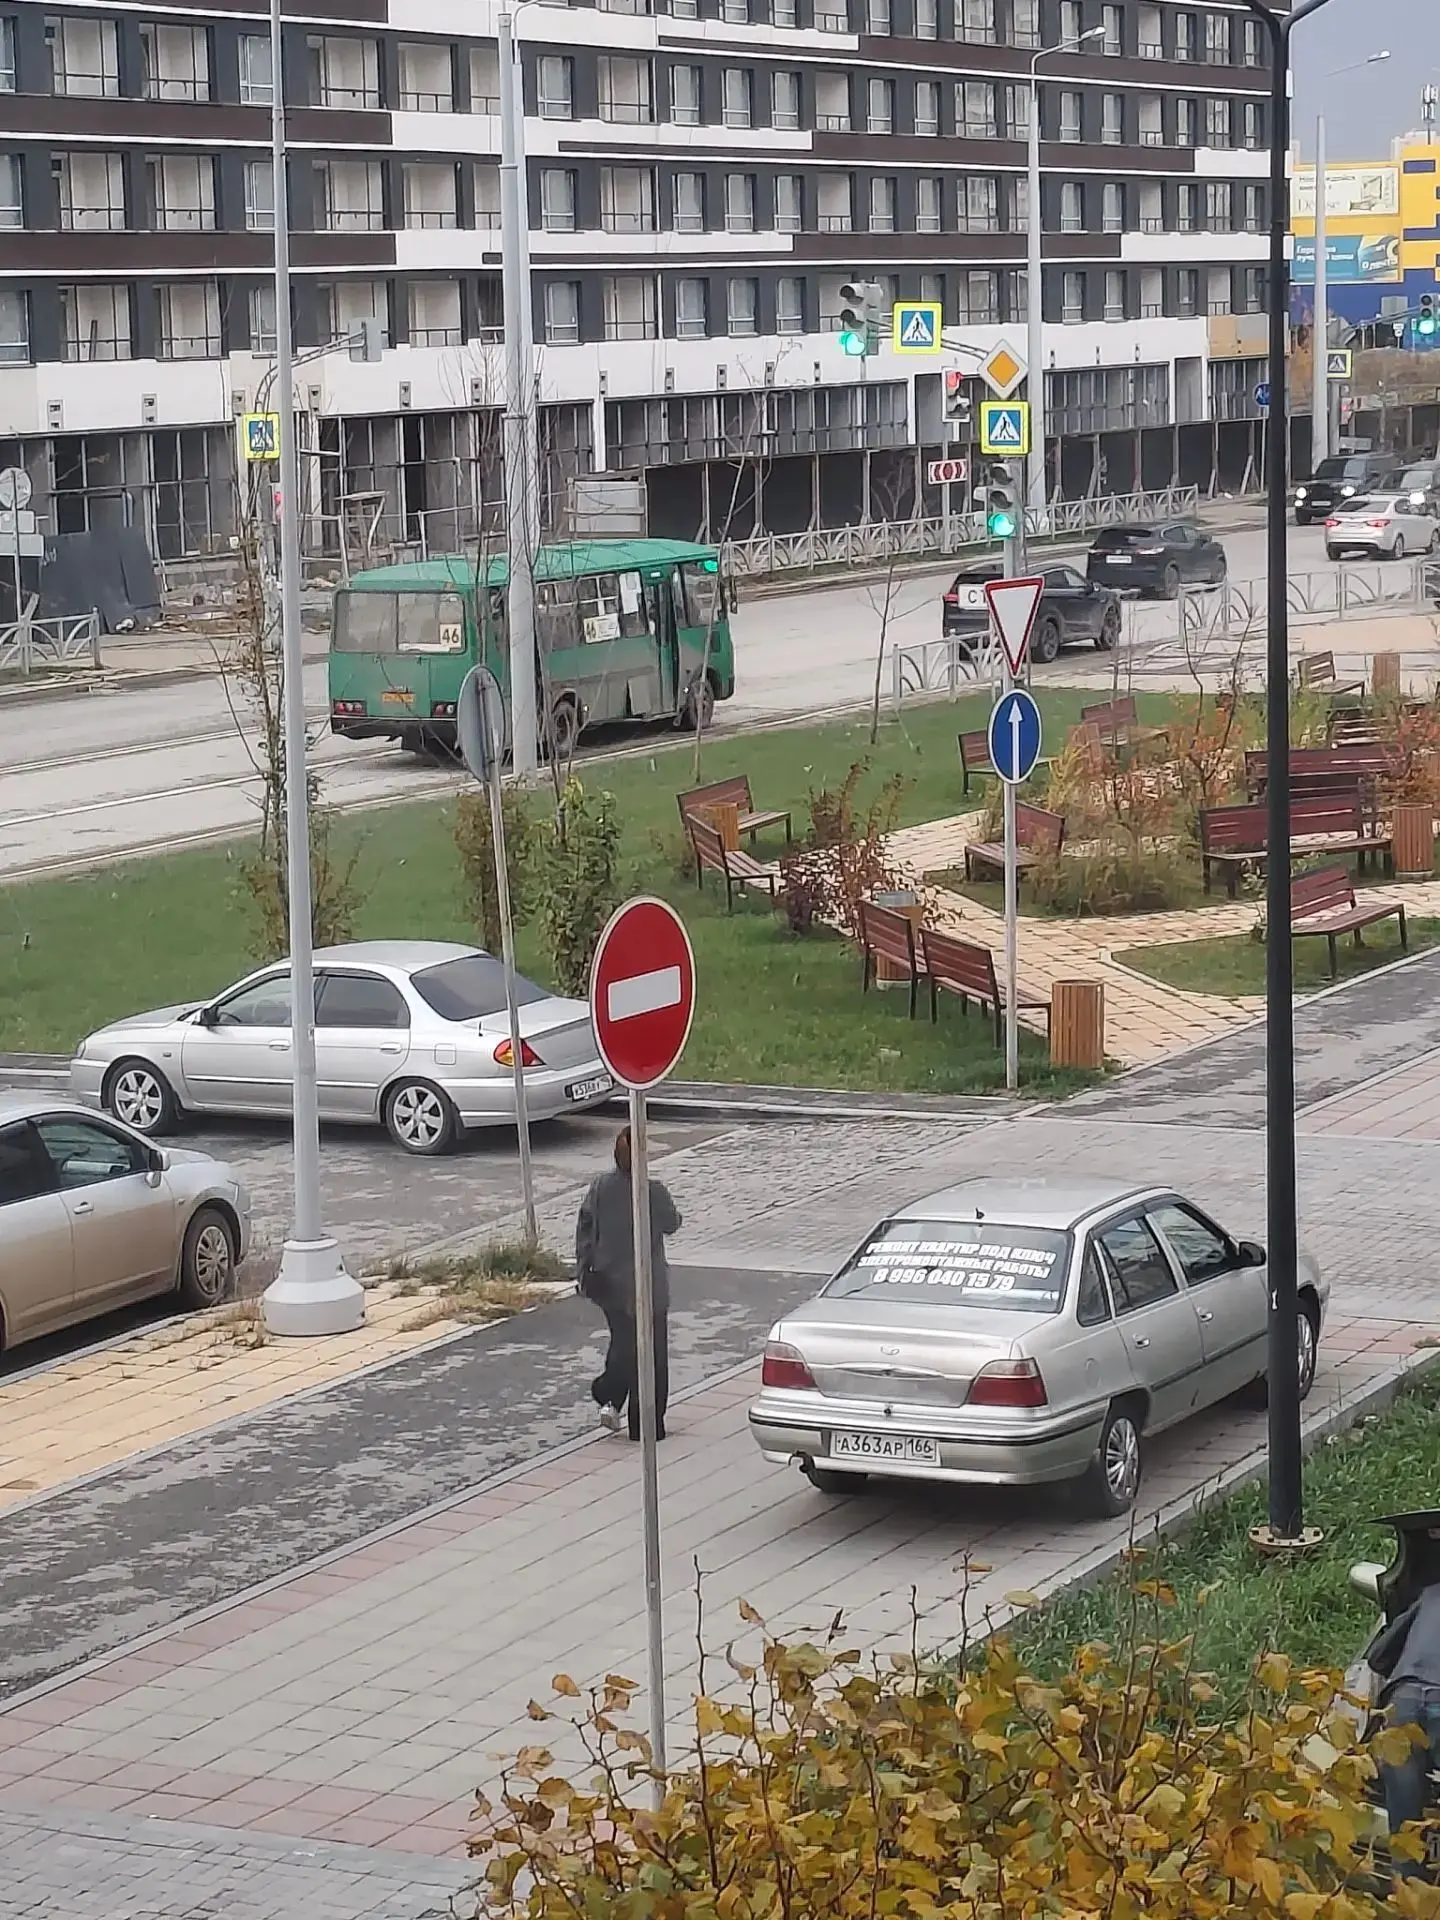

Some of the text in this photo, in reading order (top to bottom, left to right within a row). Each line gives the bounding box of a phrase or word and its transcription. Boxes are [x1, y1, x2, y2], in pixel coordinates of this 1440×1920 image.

[442, 628, 460, 643] 46
[866, 1241, 920, 1254] РЕМОНТ
[918, 1241, 980, 1255] КВАРТИР
[979, 1244, 1012, 1259] ПОД
[992, 1260, 1051, 1278] РАБОТЫ
[873, 1268, 1016, 1291] 8 996 040 15 79
[841, 1434, 933, 1456] А363АР 166
